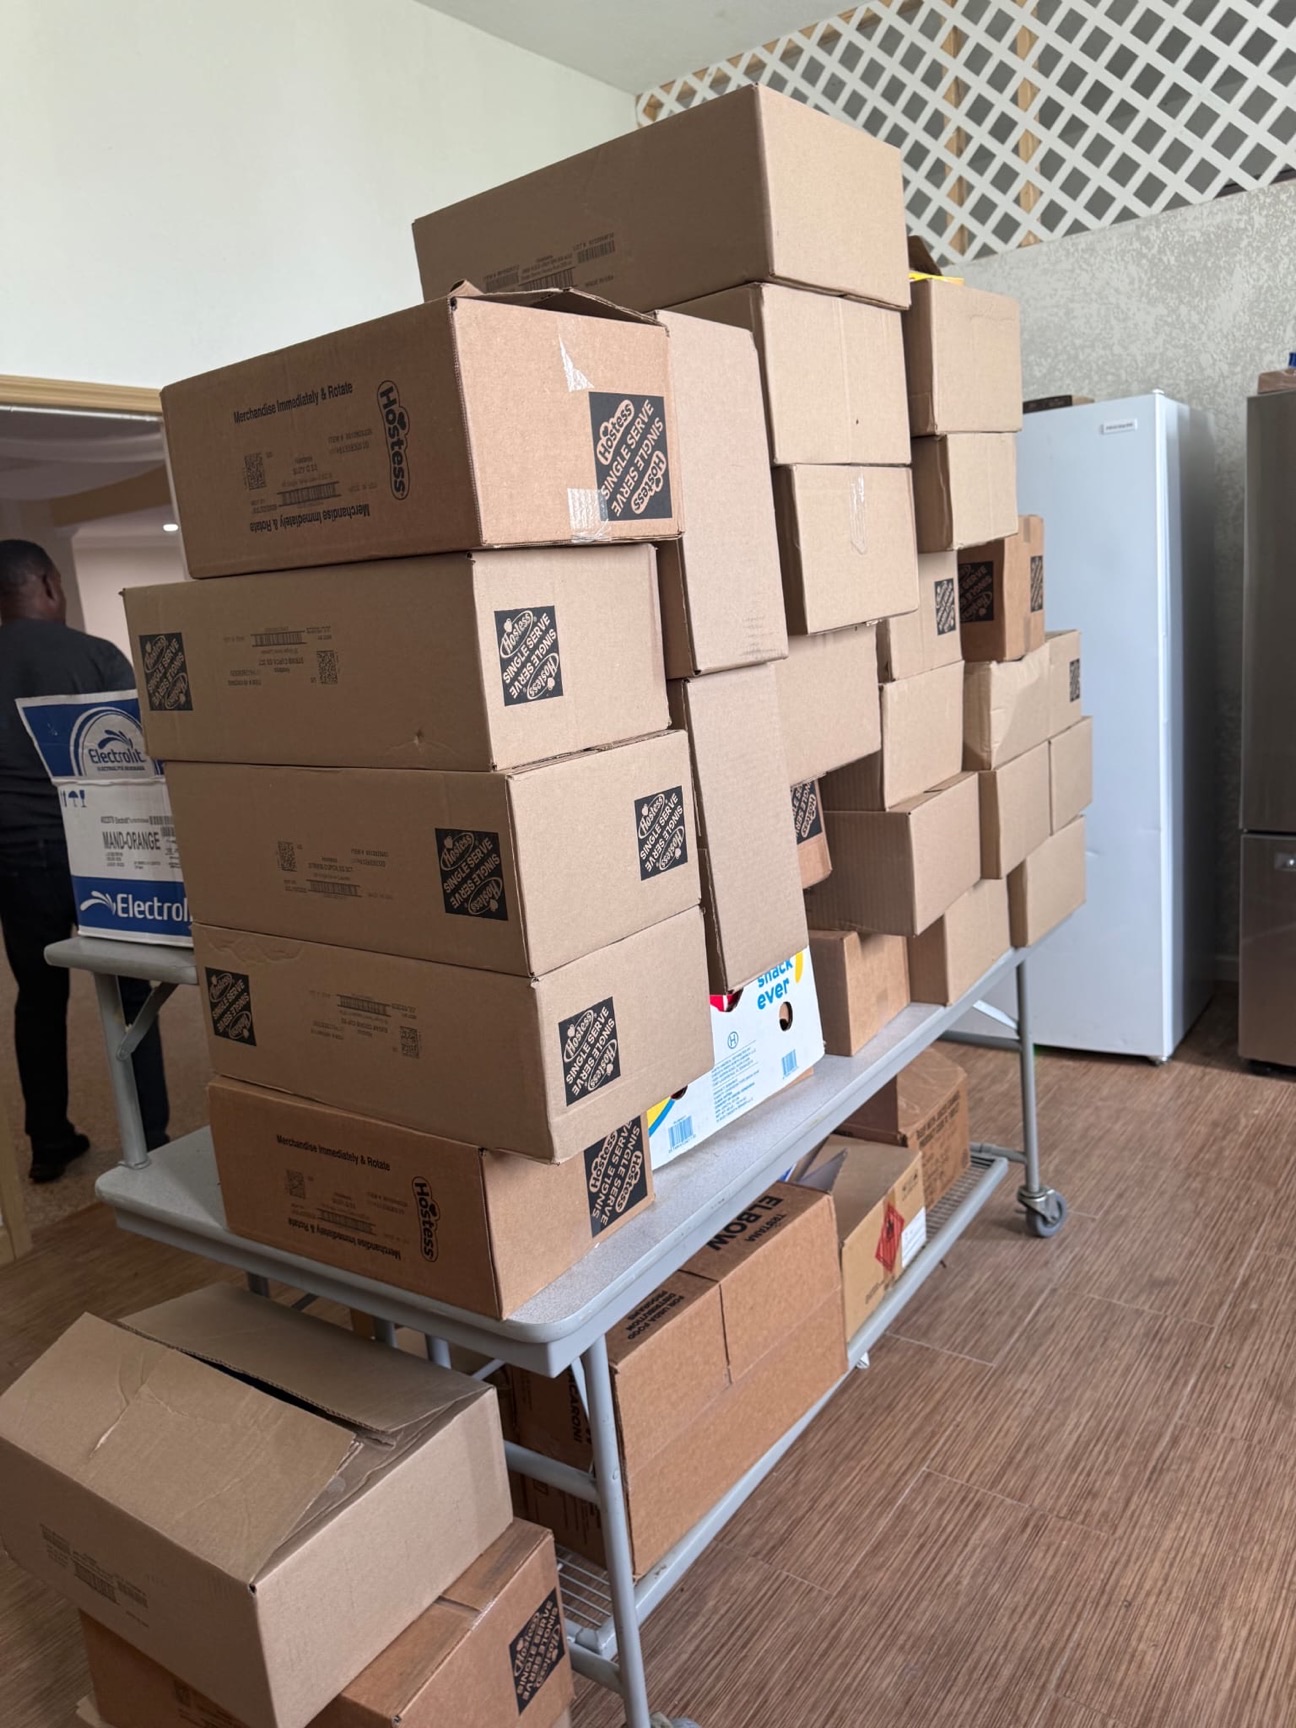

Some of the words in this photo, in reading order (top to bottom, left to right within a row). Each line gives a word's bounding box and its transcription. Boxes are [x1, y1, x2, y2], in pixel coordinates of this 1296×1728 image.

[233, 403, 276, 424] Merchandise
[277, 391, 319, 413] Immediately
[321, 388, 327, 400] &
[328, 382, 353, 399] Rotate
[379, 386, 405, 493] Hostess
[599, 403, 632, 461] Hostess
[600, 445, 631, 500] SINGLE
[627, 399, 654, 449] SERVE
[634, 417, 664, 471] SINGLE
[611, 467, 639, 517] SERVE
[633, 454, 665, 511] Hostess
[250, 521, 272, 532] Rotate
[280, 511, 322, 528] Immediately
[323, 503, 371, 520] Merchandise
[502, 613, 531, 654] Hostess
[503, 645, 529, 684] SINGLE
[526, 612, 550, 649] SERVE
[531, 629, 556, 666] SINGLE
[509, 662, 534, 699] SERVE
[529, 656, 557, 697] Hostess
[88, 748, 147, 764] Electrolit
[640, 796, 662, 835] Hostess
[640, 824, 662, 860] SINGLE
[659, 793, 679, 826] SERVE
[662, 805, 683, 841] SINGLE
[102, 831, 161, 850] MAND-ORANGE
[442, 835, 472, 867] Hostess
[645, 838, 665, 872] SERVE
[661, 830, 683, 868] Hostess
[443, 862, 470, 893] SINGLE
[467, 837, 493, 868] SERVE
[472, 854, 500, 885] SINGLE
[117, 893, 193, 922] Electrol
[450, 880, 475, 909] SERVE
[471, 880, 500, 912] Hostess
[757, 977, 790, 1010] ever
[565, 1012, 592, 1057] Hostess
[566, 1042, 591, 1084] SINGLE
[587, 1006, 609, 1045] SERVE
[592, 1018, 615, 1058] SINGLE
[571, 1056, 595, 1096] SERVE
[590, 1045, 616, 1088] Hostess
[276, 1134, 318, 1153] Merchandise
[318, 1144, 359, 1166] Immediately
[360, 1155, 366, 1165] &
[367, 1156, 391, 1172] Rotate
[591, 1133, 616, 1189] Hostess
[618, 1125, 640, 1177] SINGLE
[592, 1165, 616, 1219] SINGLE
[600, 1177, 622, 1226] SERVE
[617, 1154, 642, 1211] Hostess
[414, 1182, 437, 1260] Hostess
[707, 1195, 784, 1251] ELBOW
[627, 1322, 650, 1340] FOOD
